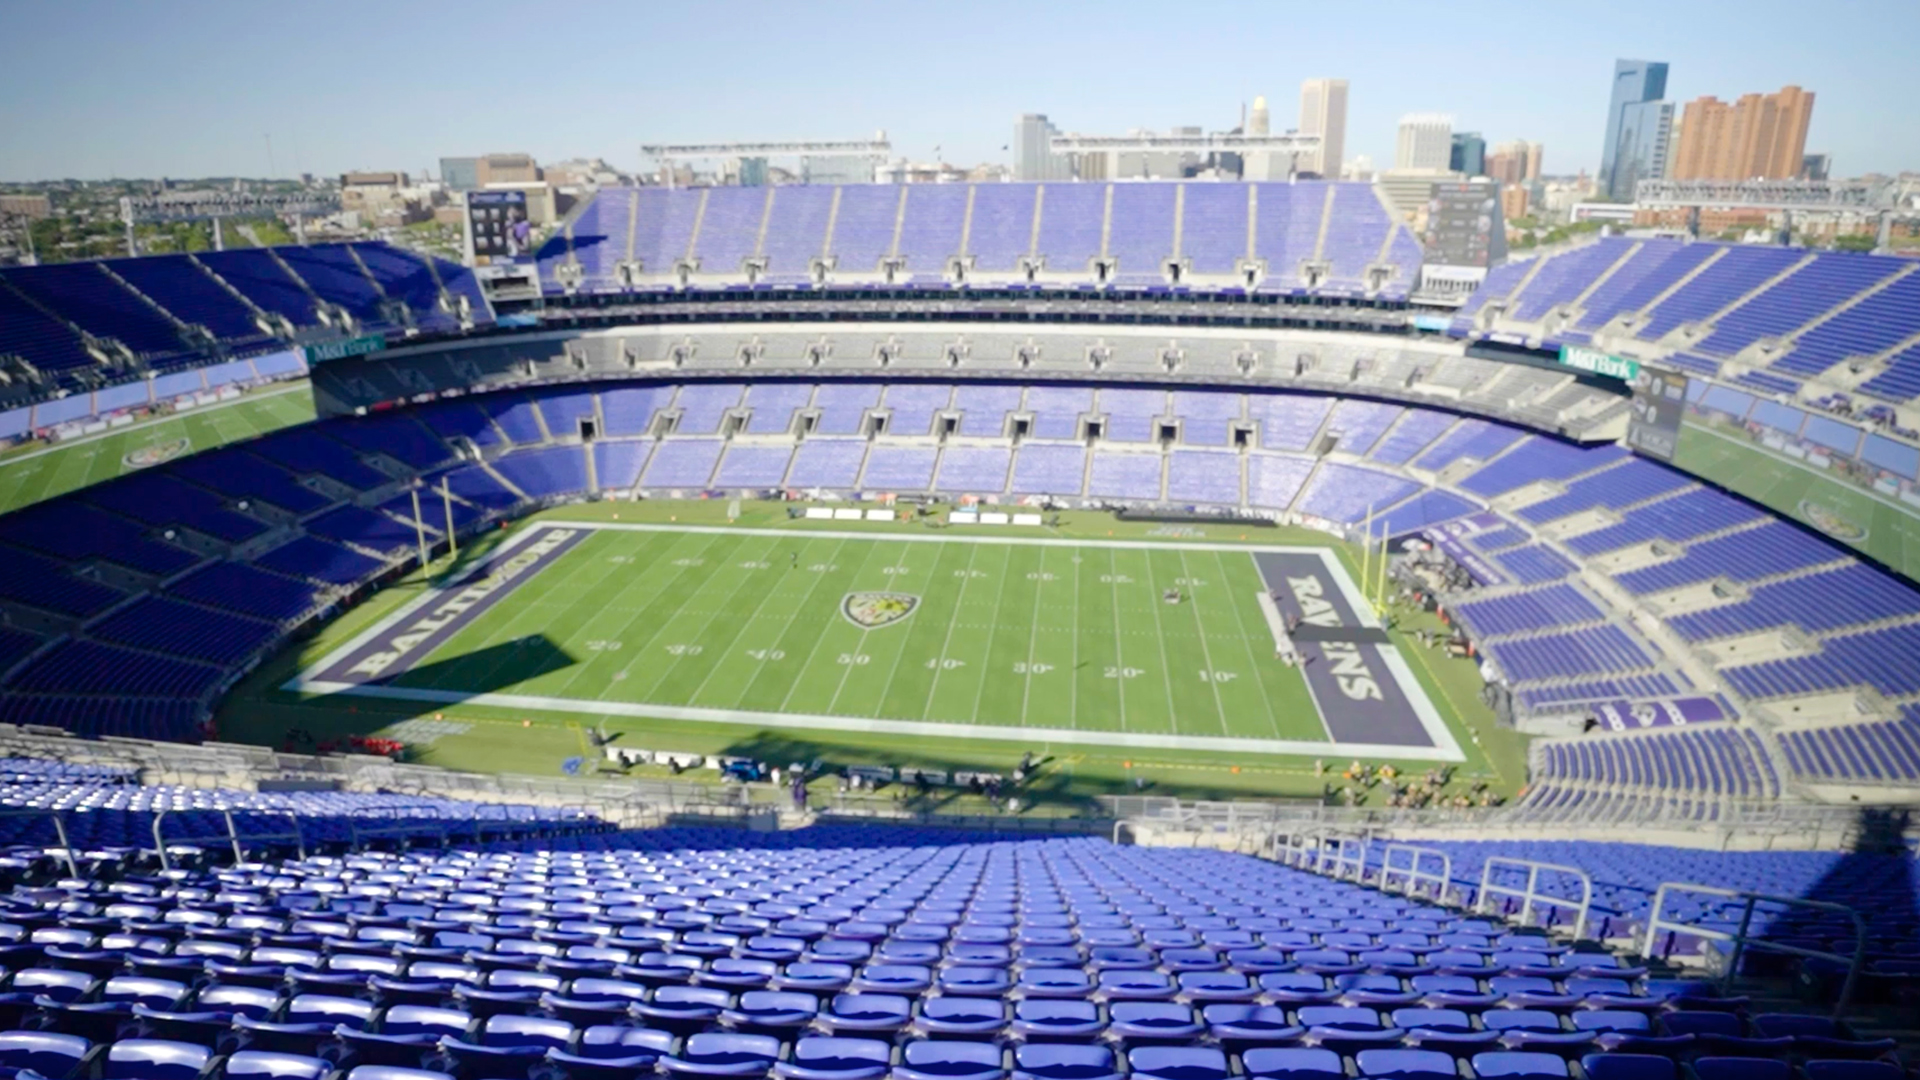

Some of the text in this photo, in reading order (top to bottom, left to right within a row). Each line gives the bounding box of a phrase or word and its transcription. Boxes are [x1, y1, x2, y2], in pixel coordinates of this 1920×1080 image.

[342, 529, 577, 678] BALTIMORE
[836, 653, 870, 665] 50
[1012, 662, 1046, 674] 30
[1104, 666, 1137, 678] 20
[1199, 670, 1231, 682] 10
